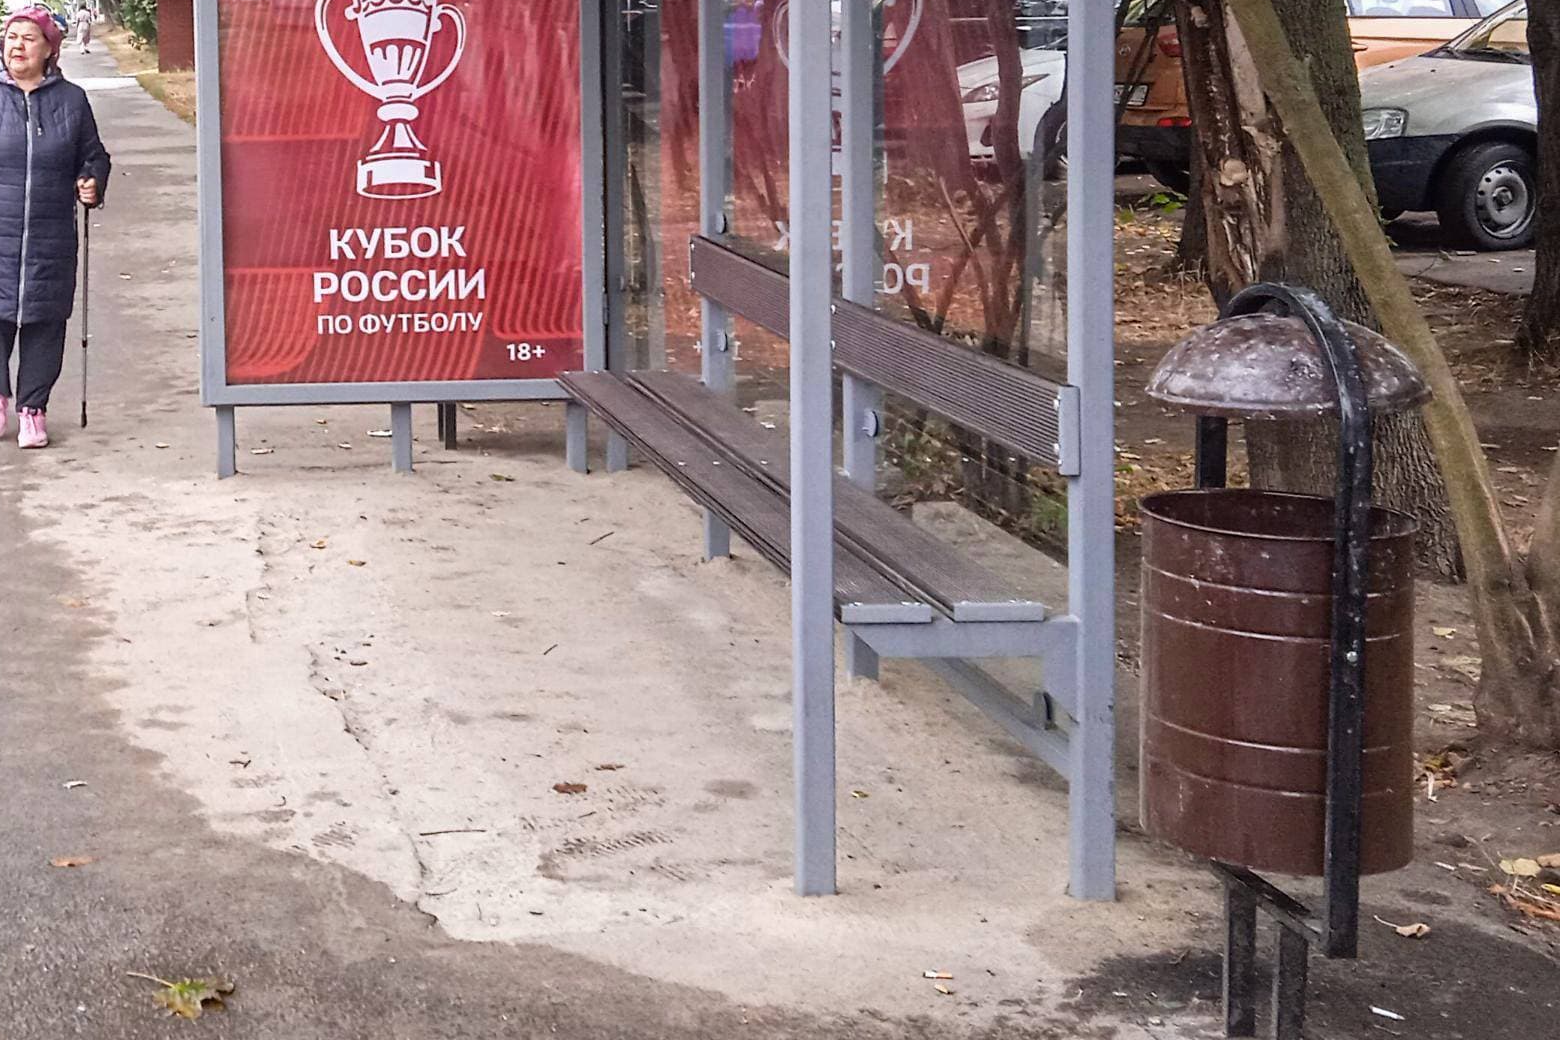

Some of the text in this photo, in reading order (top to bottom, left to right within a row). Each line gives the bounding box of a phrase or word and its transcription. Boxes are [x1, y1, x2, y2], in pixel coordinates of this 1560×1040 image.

[328, 225, 467, 260] КУБОК
[313, 268, 486, 303] РОССИИ
[317, 311, 483, 335] ПО ФУТБОЛУ
[506, 342, 546, 361] 18+
